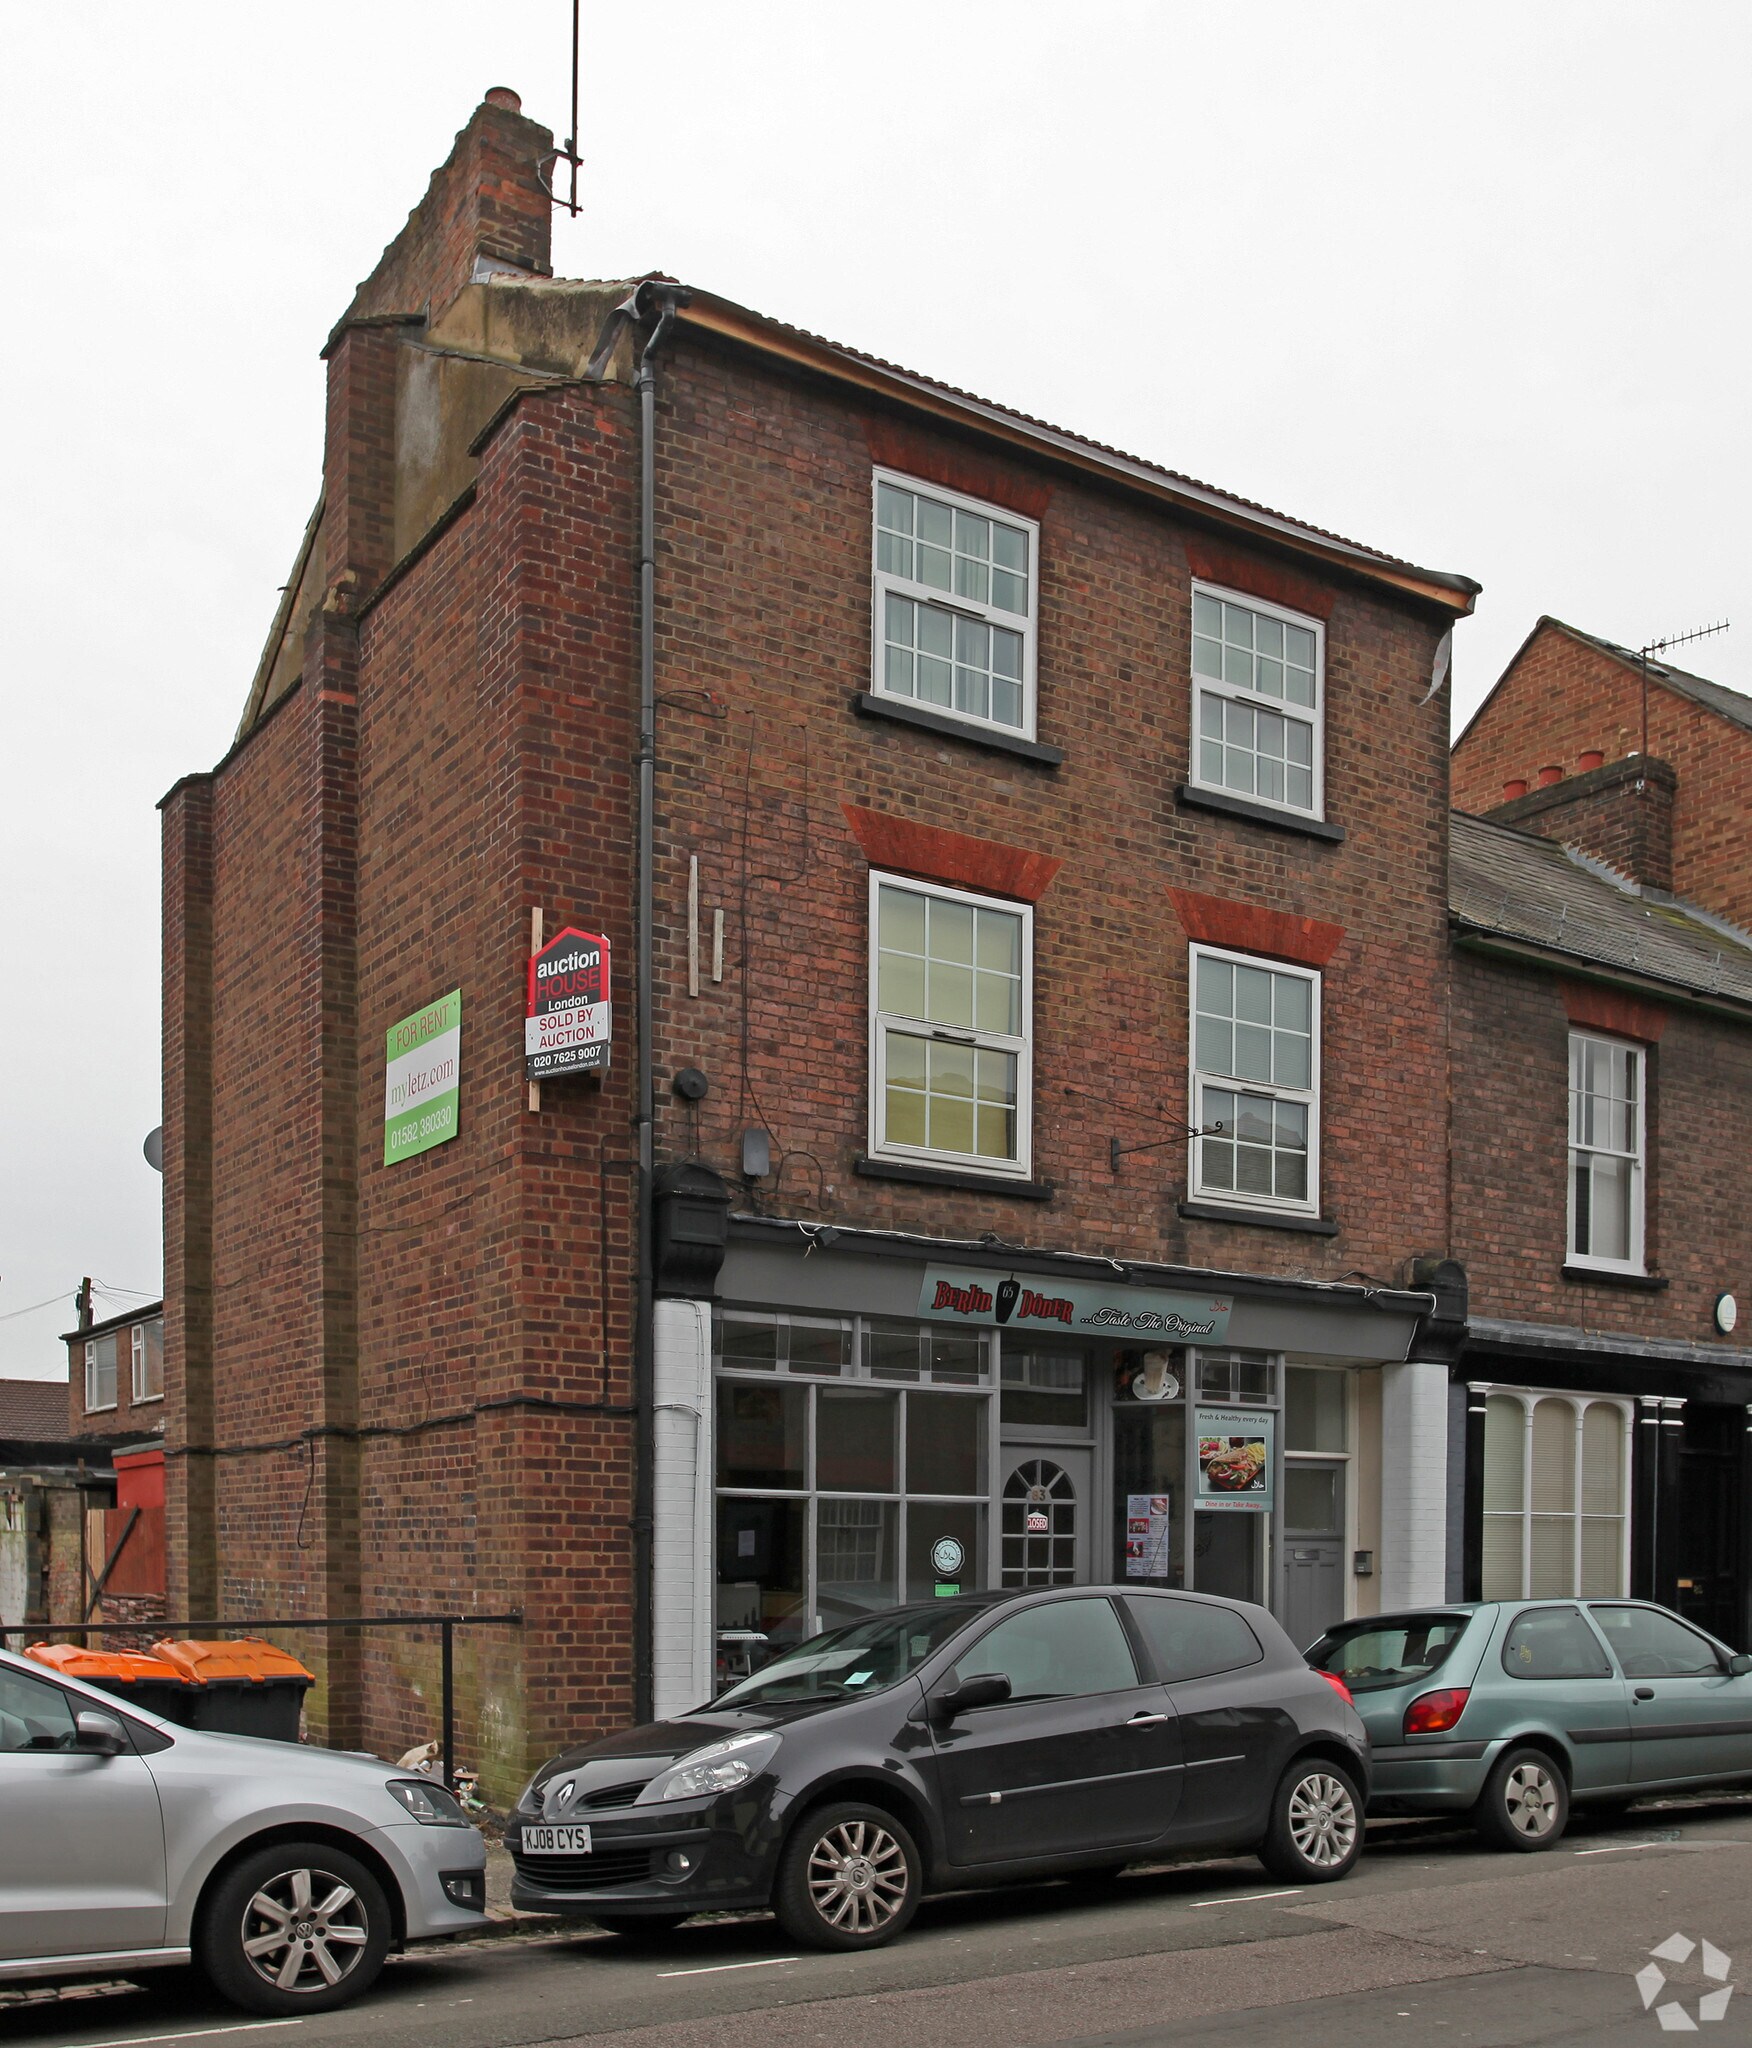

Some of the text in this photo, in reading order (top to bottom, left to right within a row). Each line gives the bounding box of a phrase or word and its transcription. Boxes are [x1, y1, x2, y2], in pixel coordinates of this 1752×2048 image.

[537, 951, 600, 978] auction
[537, 967, 600, 1000] HOUSE
[548, 995, 588, 1012] London
[397, 1003, 449, 1051] FOR RENT
[539, 1008, 593, 1031] SOLD BY
[539, 1026, 594, 1049] AUCTION
[533, 1045, 602, 1068] 020 7625 9007
[534, 1059, 600, 1076] www.auctionhouselondon.co.uk
[391, 1059, 454, 1108] myletz.com
[391, 1105, 452, 1149] 01582 380330
[1132, 1311, 1163, 1330] The
[1164, 1313, 1215, 1338] Original
[1199, 1412, 1214, 1420] Fresh
[1220, 1414, 1242, 1423] Healthy
[1242, 1416, 1257, 1424] every
[1258, 1416, 1269, 1424] day
[525, 1828, 585, 1849] KJ08 CYS
